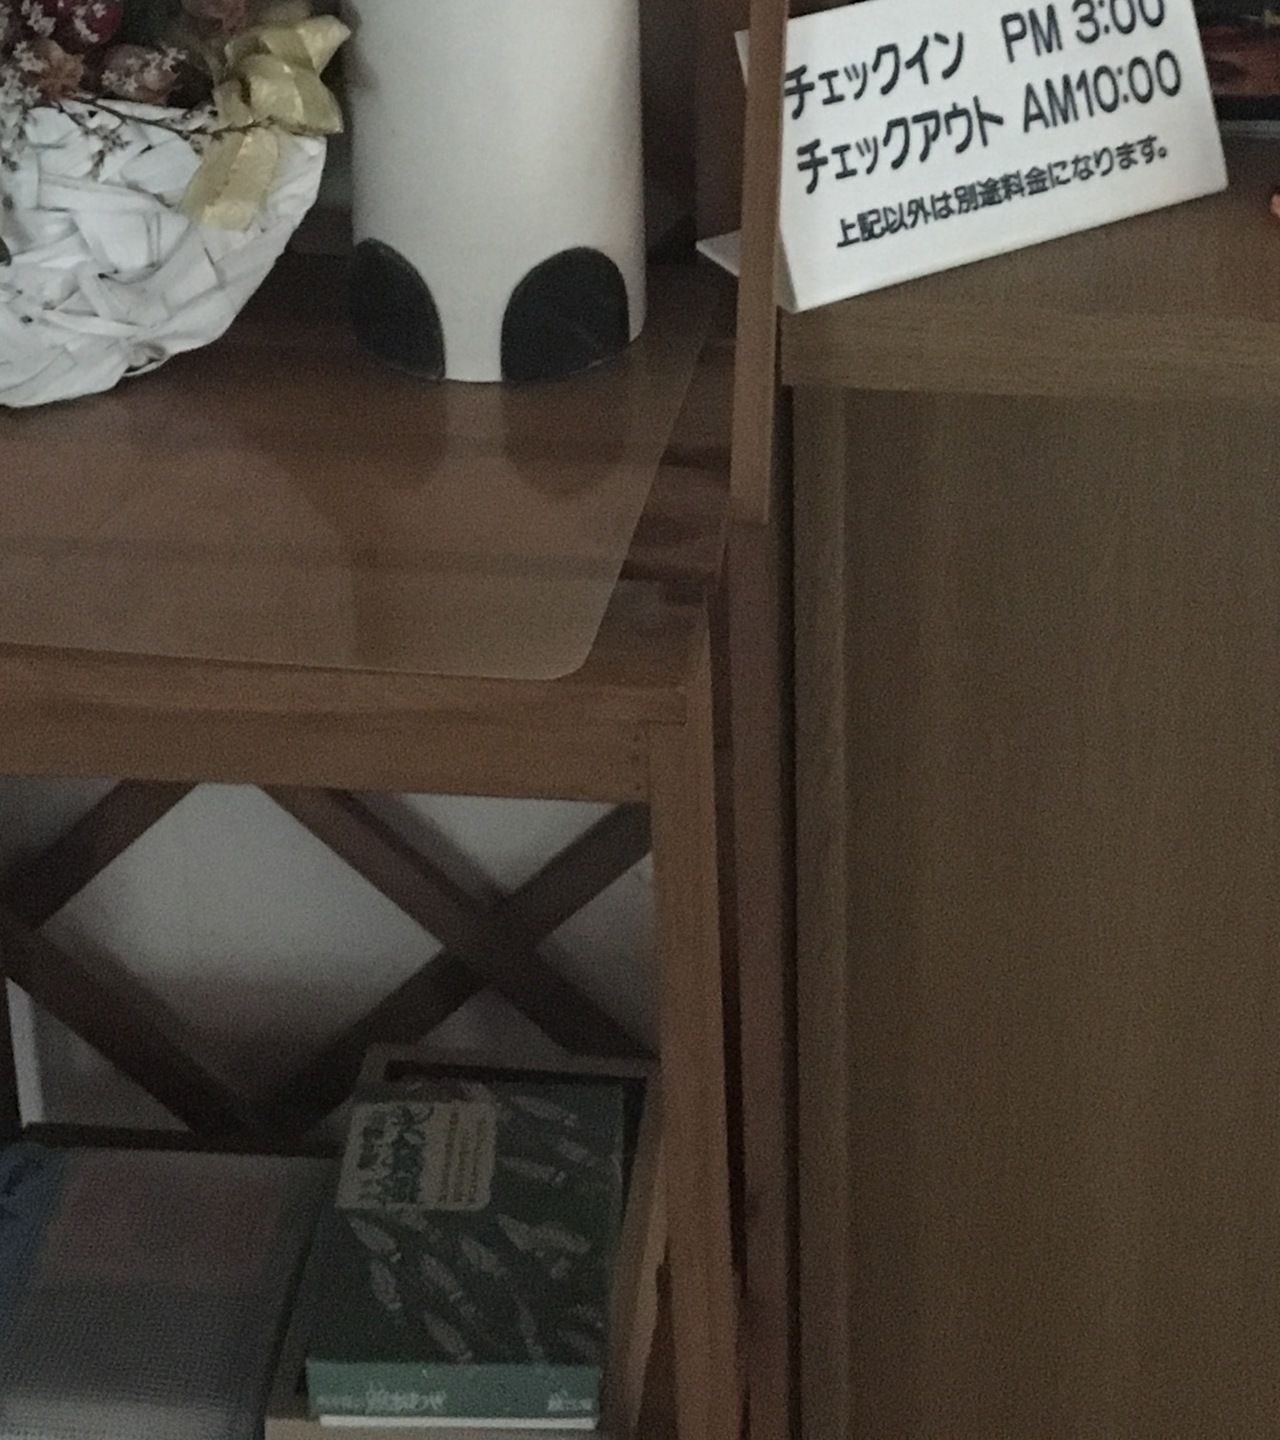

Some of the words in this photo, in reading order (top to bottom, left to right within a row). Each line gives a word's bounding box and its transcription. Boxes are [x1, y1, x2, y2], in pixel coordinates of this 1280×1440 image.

[784, 31, 965, 120] チェックイン
[1001, 4, 1063, 63] PM
[797, 95, 1004, 195] チェックアウト
[1023, 48, 1183, 133] AM10:00
[836, 134, 1170, 248] 上記以外は別途料金になります。
